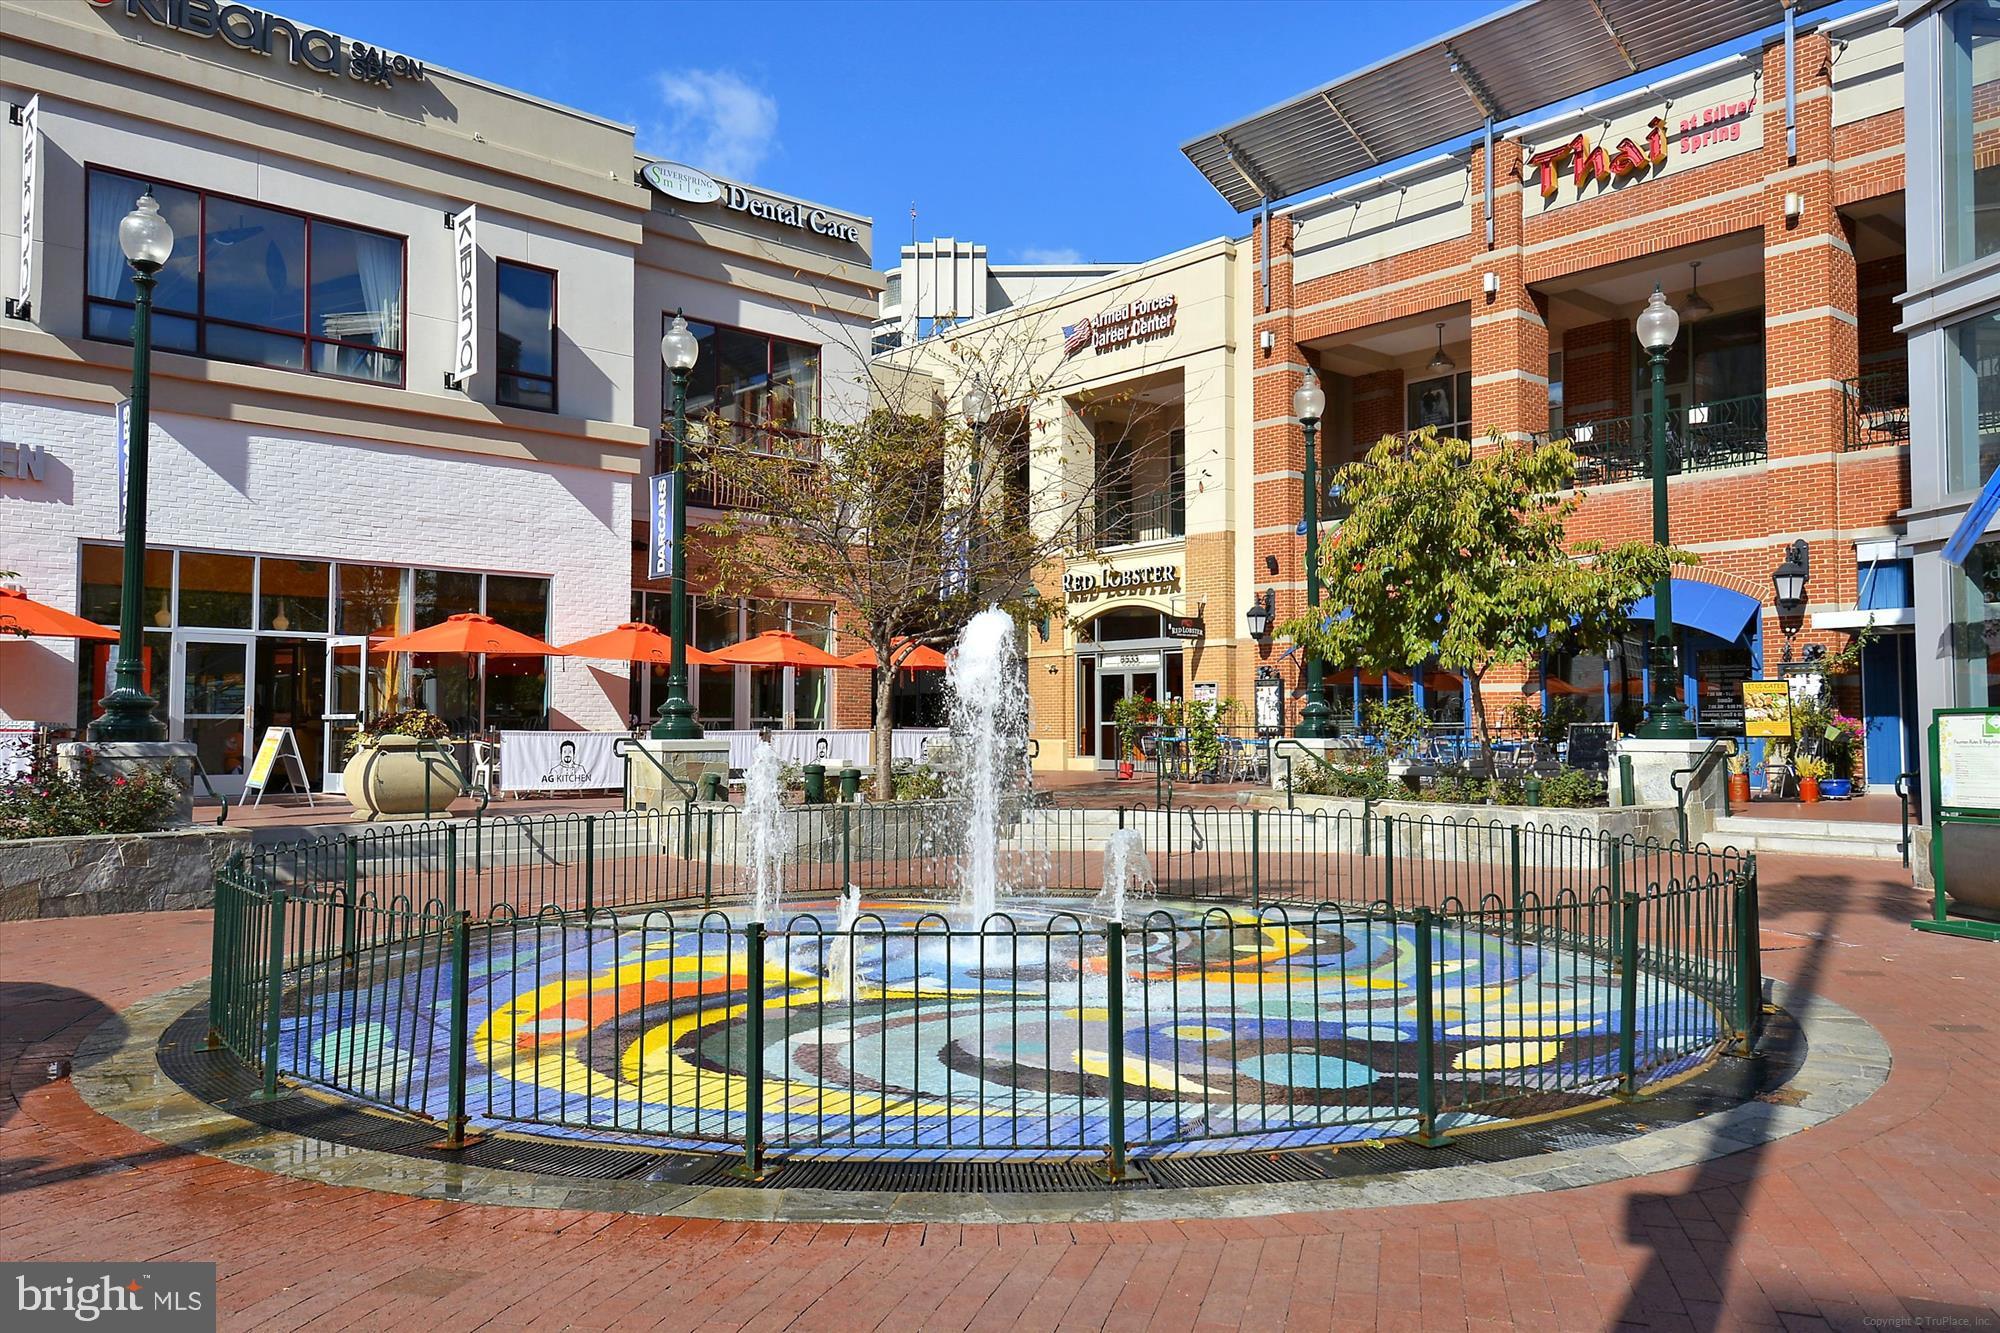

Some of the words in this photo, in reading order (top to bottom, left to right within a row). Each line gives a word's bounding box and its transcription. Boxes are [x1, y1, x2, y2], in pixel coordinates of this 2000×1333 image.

[350, 60, 393, 89] SPA
[351, 41, 425, 81] SALON
[1680, 114, 1698, 133] at
[1703, 99, 1757, 126] Silver
[1528, 115, 1669, 198] Thai
[726, 184, 804, 228] Dental
[809, 210, 859, 242] Care
[1091, 305, 1130, 328] Armed
[1131, 293, 1175, 317] Forces
[1091, 325, 1131, 348] Career
[1132, 313, 1173, 335] Center
[658, 479, 667, 573] DARCARS
[1061, 573, 1097, 593] RED
[1101, 564, 1177, 588] LOBSTER
[541, 774, 555, 783] AG
[556, 773, 592, 783] KITCHEN
